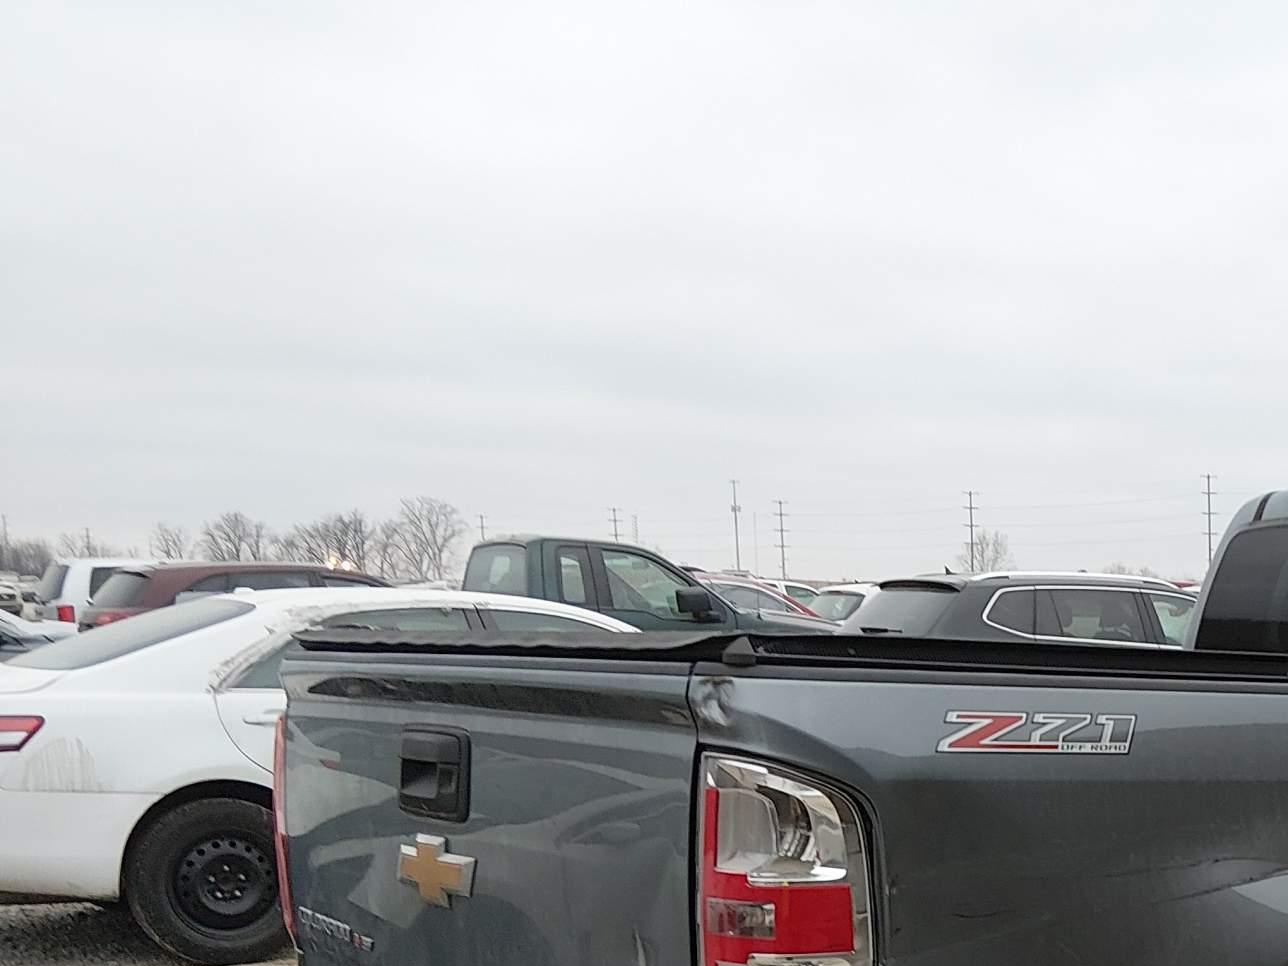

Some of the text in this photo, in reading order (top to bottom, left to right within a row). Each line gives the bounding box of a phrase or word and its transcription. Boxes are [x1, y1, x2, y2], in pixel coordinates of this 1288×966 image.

[936, 710, 1137, 753] Z71
[1060, 743, 1127, 752] OFF ROAD
